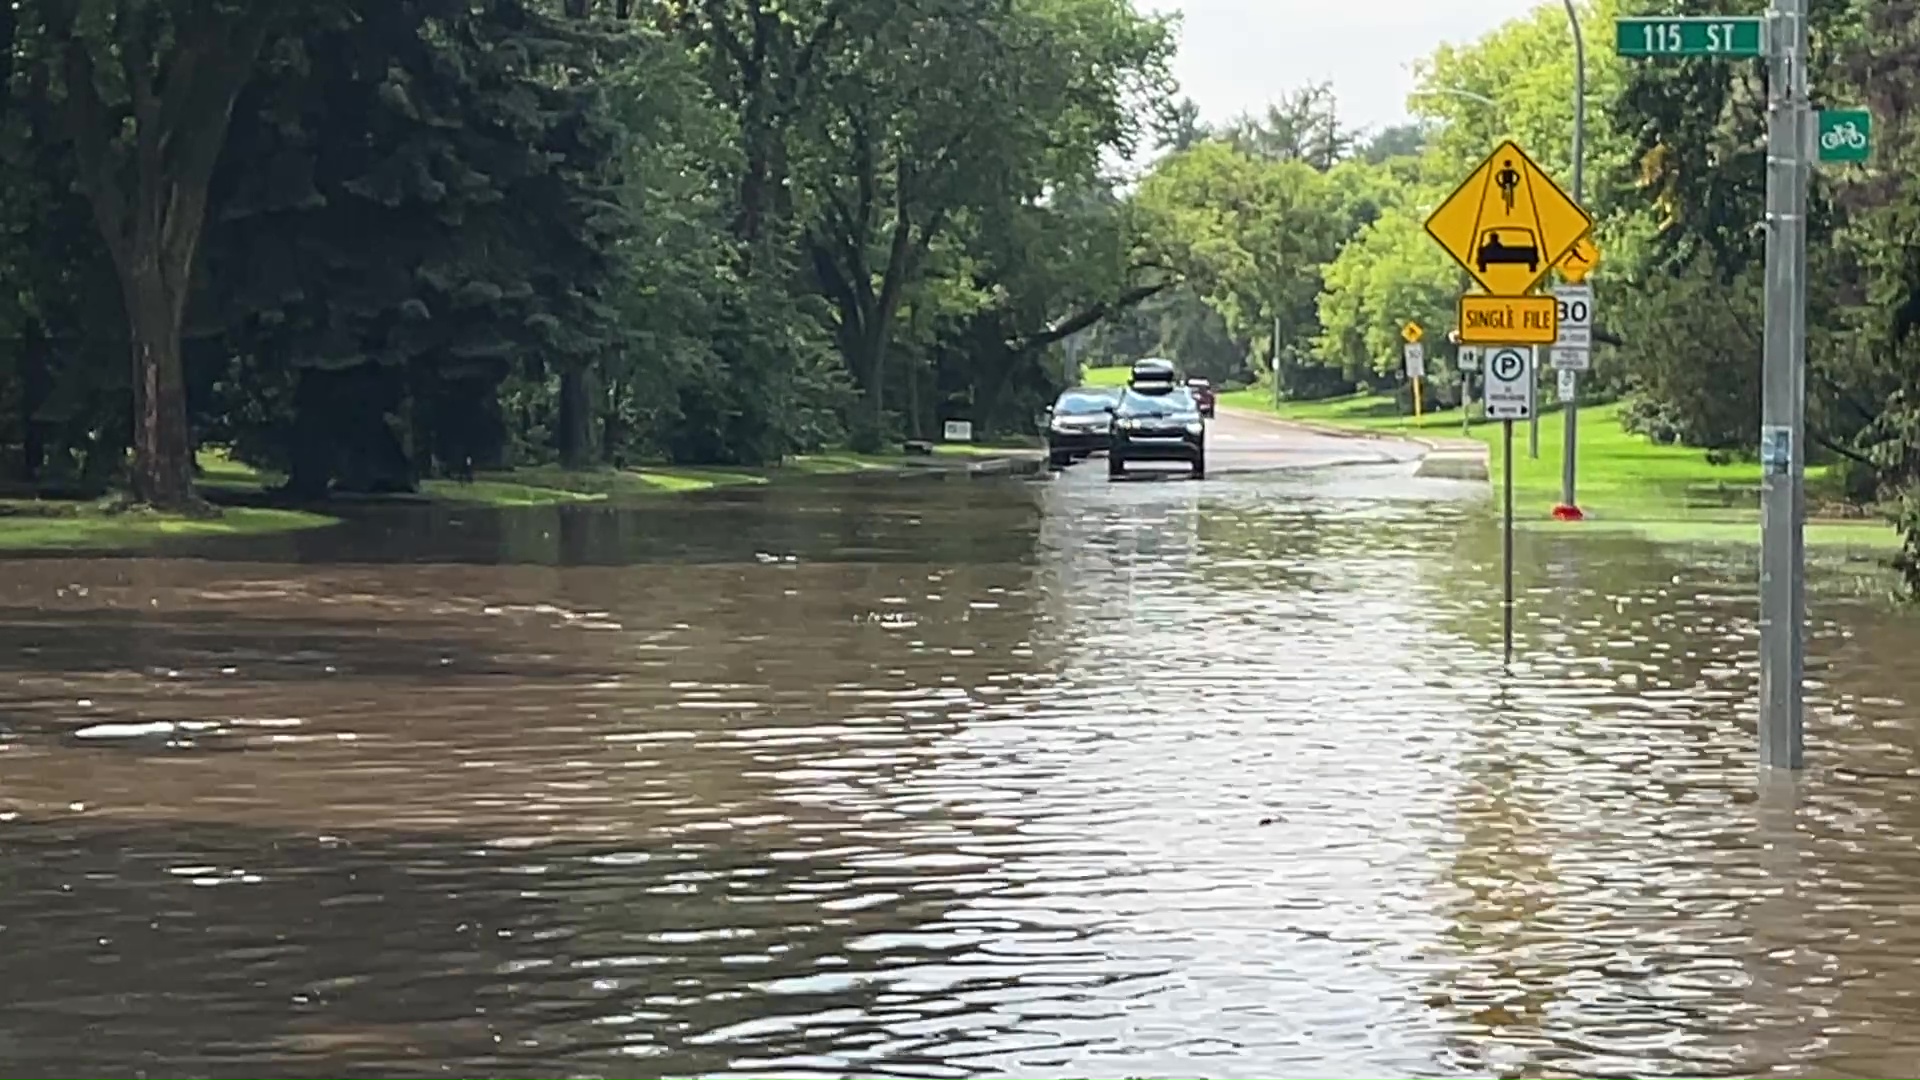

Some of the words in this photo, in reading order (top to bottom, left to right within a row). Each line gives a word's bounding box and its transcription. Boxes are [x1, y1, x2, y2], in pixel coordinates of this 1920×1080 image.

[1643, 23, 1682, 52] 115
[1706, 23, 1735, 52] ST
[1465, 309, 1515, 329] SINGLE
[1523, 309, 1551, 329] FILE
[1557, 301, 1588, 323] 30
[1501, 357, 1517, 375] P
